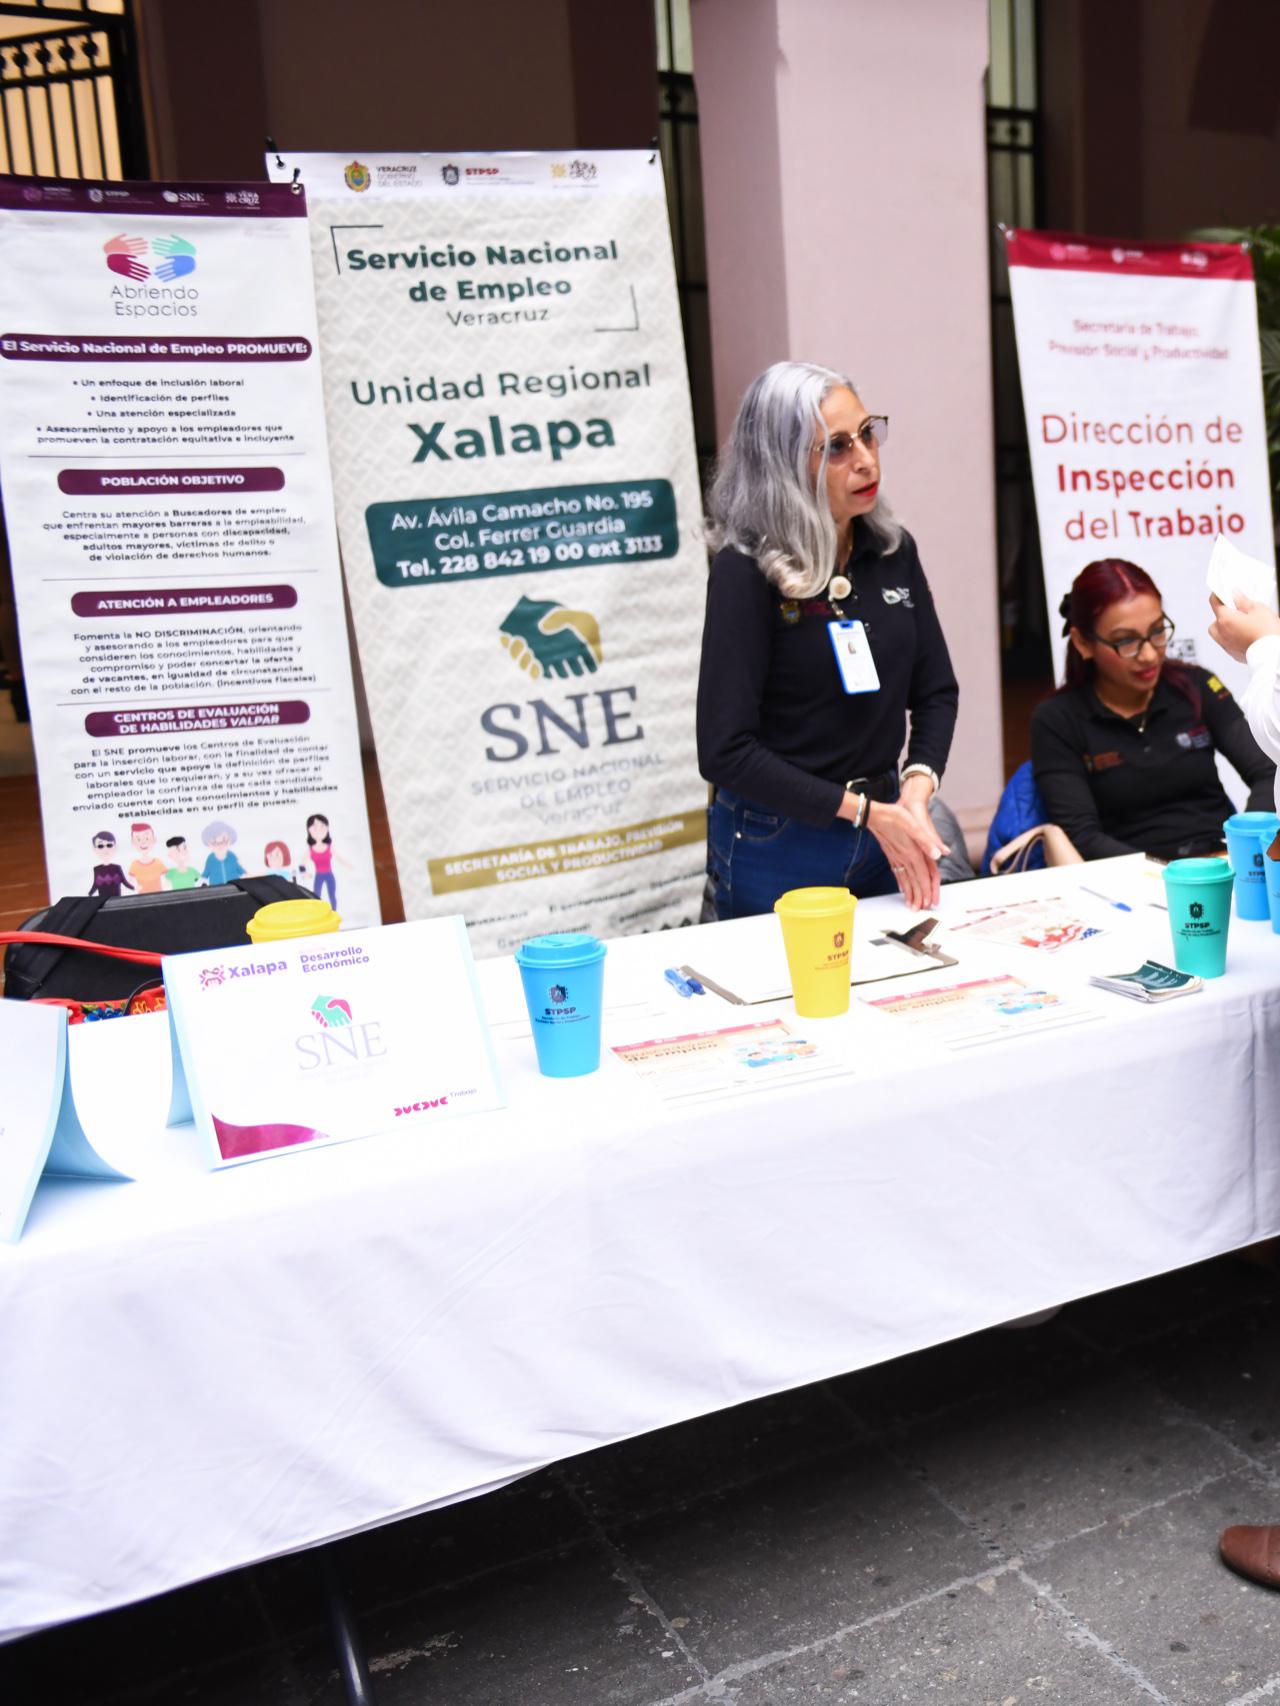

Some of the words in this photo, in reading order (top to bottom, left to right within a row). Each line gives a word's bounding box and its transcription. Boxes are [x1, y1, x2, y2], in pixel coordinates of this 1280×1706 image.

[347, 247, 476, 271] Servicio
[486, 241, 618, 265] Nacional
[110, 285, 199, 300] Abriendo
[408, 282, 447, 302] de
[456, 277, 572, 303] Empleo
[114, 301, 198, 320] Espacios
[446, 308, 548, 326] Veracruz
[3, 341, 17, 351] El
[20, 341, 80, 353] Servicio
[82, 343, 146, 354] Nacional
[148, 344, 168, 354] de
[170, 345, 224, 357] Empleo
[227, 344, 307, 355] PROMUEVE:
[81, 379, 96, 387] Un
[98, 379, 142, 389] enfoque
[144, 379, 158, 387] de
[160, 379, 207, 387] inclusión
[210, 379, 244, 387] laboral
[350, 375, 485, 406] Unidad
[498, 364, 650, 401] Regional
[100, 394, 172, 402] Identificación
[175, 394, 188, 402] de
[190, 394, 230, 404] perfiles
[96, 409, 117, 417] Una
[120, 409, 165, 417] atención
[168, 408, 236, 419] especializada
[46, 425, 126, 433] Asesoramiento
[137, 427, 170, 435] apoyo
[180, 425, 194, 433] los
[197, 424, 262, 434] empleadores
[1042, 412, 1193, 444] Dirección
[1204, 414, 1243, 443] de
[37, 436, 98, 444] promueven
[100, 435, 110, 443] la
[113, 435, 179, 443] contratación
[182, 434, 232, 444] equitativa
[406, 414, 616, 465] Xalapa
[101, 472, 179, 487] POBLACIÓN
[181, 473, 245, 485] OBJETIVO
[1058, 460, 1234, 498] Inspección
[62, 510, 98, 519] Centra
[116, 508, 160, 517] atención
[172, 507, 232, 516] Buscadores
[392, 515, 422, 531] Av.
[427, 509, 477, 527] Ávila
[482, 500, 581, 522] Camacho
[584, 497, 618, 513] No.
[620, 492, 653, 510] 195
[42, 523, 63, 531] que
[66, 520, 118, 529] enfrentan
[121, 521, 166, 530] mayores
[169, 519, 212, 527] barreras
[1064, 509, 1118, 540] del
[1127, 505, 1245, 541] Trabajo
[63, 530, 142, 541] especialmente
[152, 530, 198, 539] personas
[434, 533, 474, 552] Col.
[478, 528, 540, 547] Ferrer
[546, 518, 626, 540] Guardia
[82, 542, 123, 550] adultos
[222, 538, 236, 546] de
[105, 552, 153, 561] violación
[172, 550, 219, 559] derechos
[396, 559, 436, 578] Tel.
[440, 554, 479, 573] 228
[484, 550, 524, 569] 842
[527, 548, 550, 565] 19
[554, 544, 583, 563] 00
[588, 541, 621, 560] ext
[624, 537, 662, 556] 3133
[98, 595, 164, 610] ATENCIÓN
[167, 596, 177, 607] A
[180, 592, 274, 607] EMPLEADORES
[74, 631, 120, 641] Fomenta
[94, 641, 154, 651] asesorando
[165, 640, 180, 648] los
[182, 637, 248, 648] empleadores
[79, 653, 137, 662] consideren
[140, 652, 154, 660] los
[90, 662, 155, 673] compromiso
[167, 660, 196, 671] poder
[200, 656, 248, 666] concertar
[167, 668, 212, 680] igualdad
[231, 664, 303, 675] circunstancias
[105, 684, 131, 693] resto
[114, 710, 175, 723] CENTROS
[177, 708, 195, 719] DE
[198, 702, 279, 718] EVALUACIÓN
[120, 724, 137, 735] DE
[141, 718, 227, 733] HABILIDADES
[229, 715, 280, 728] VALPAR
[480, 686, 646, 764] SNE
[300, 946, 363, 963] Desarrollo
[228, 959, 288, 979] Xalapa
[302, 954, 370, 973] Económico
[545, 1007, 576, 1015] STPSP
[295, 1021, 388, 1071] SNE
